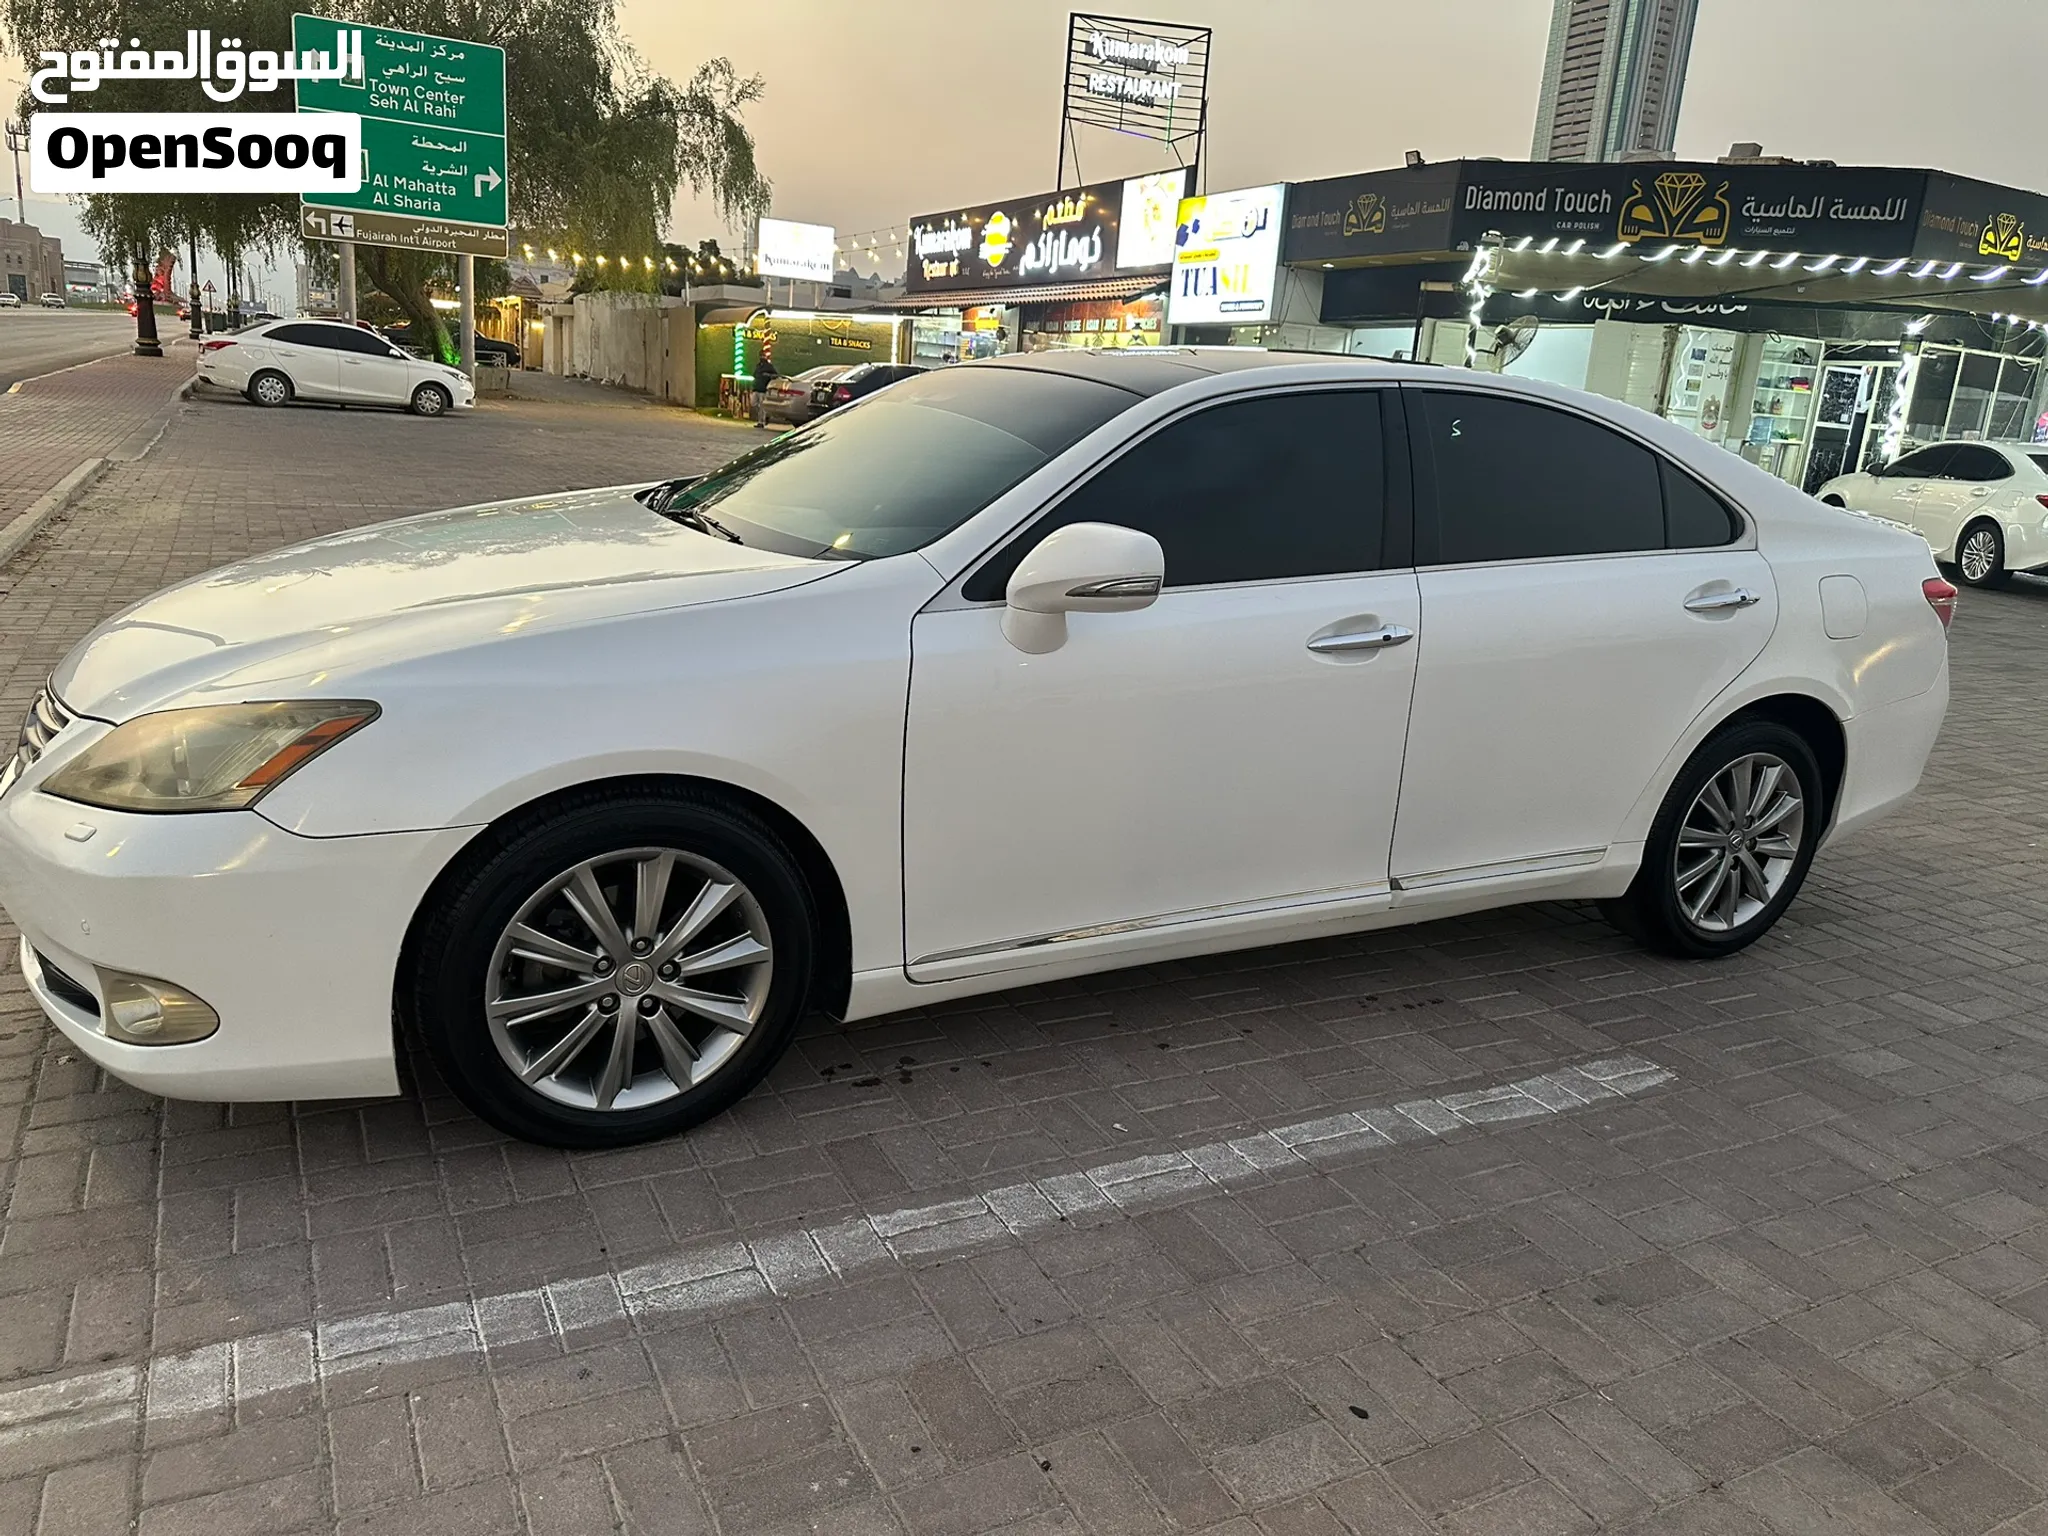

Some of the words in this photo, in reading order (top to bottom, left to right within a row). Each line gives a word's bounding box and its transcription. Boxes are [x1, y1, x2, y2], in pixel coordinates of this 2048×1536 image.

[375, 33, 425, 53] المدينة
[429, 44, 465, 61] مركز
[1089, 29, 1190, 67] Kumarakom
[382, 62, 428, 80] الراهي
[434, 71, 466, 85] سيح
[368, 78, 409, 97] Town
[414, 85, 465, 105] Center
[1088, 72, 1182, 100] RESTAURANT
[369, 93, 399, 110] Seh
[403, 98, 419, 114] Al
[424, 101, 456, 119] Rahi
[411, 134, 467, 153] المحطة
[421, 160, 468, 177] الشرية
[373, 173, 389, 188] Al
[394, 175, 457, 197] Mahatta
[373, 191, 389, 206] Al
[393, 193, 442, 212] Sharia
[1465, 185, 1548, 212] Diamond
[1555, 187, 1612, 214] Touch
[1741, 195, 1825, 223] الماسية
[1829, 197, 1908, 221] اللمسة
[413, 223, 443, 234] الدولي
[1291, 212, 1319, 230] Diamond
[1320, 209, 1341, 227] Touch
[1556, 221, 1572, 229] CAR
[1573, 221, 1600, 230] POLISH
[1922, 209, 1957, 232] Diamond
[1956, 216, 1979, 238] Touch
[356, 229, 397, 242] Fujairah
[422, 237, 457, 249] Airport
[444, 226, 479, 238] الفجيرة
[482, 231, 505, 241] مطار
[831, 337, 844, 346] TEA
[848, 338, 871, 349] SNACKS
